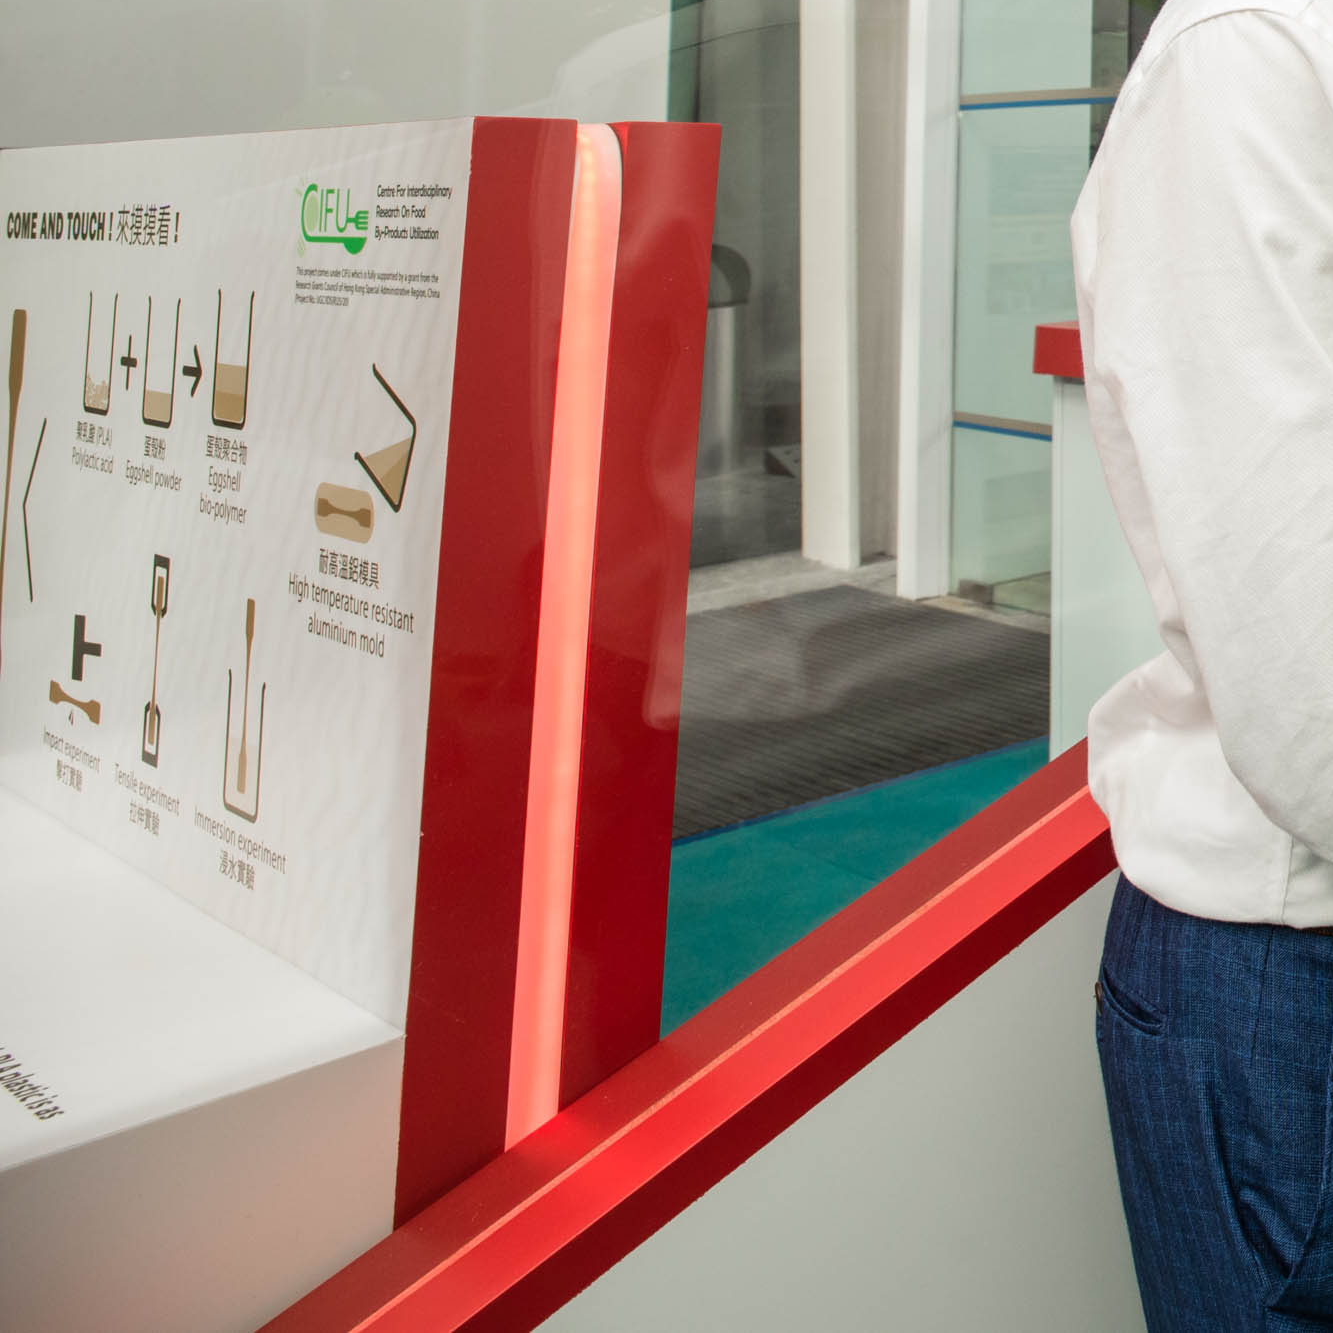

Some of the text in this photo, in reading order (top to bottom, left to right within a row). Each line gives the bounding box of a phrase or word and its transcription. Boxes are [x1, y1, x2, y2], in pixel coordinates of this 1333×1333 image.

[396, 185, 406, 197] For
[6, 212, 38, 239] COME
[40, 212, 64, 240] AND
[67, 212, 106, 241] TOUCH
[376, 205, 426, 219] Research On Food
[72, 446, 114, 474] Polylactic acid
[125, 459, 182, 491] Eggshell powder
[208, 465, 241, 493] Eggshell
[200, 493, 248, 524] bio-polymer
[288, 571, 415, 633] High temperature resistant
[308, 611, 385, 658] aluminium mold
[64, 739, 101, 773] experiment
[115, 763, 181, 817] Tensile experiment
[194, 805, 287, 875] Immersion experiment
